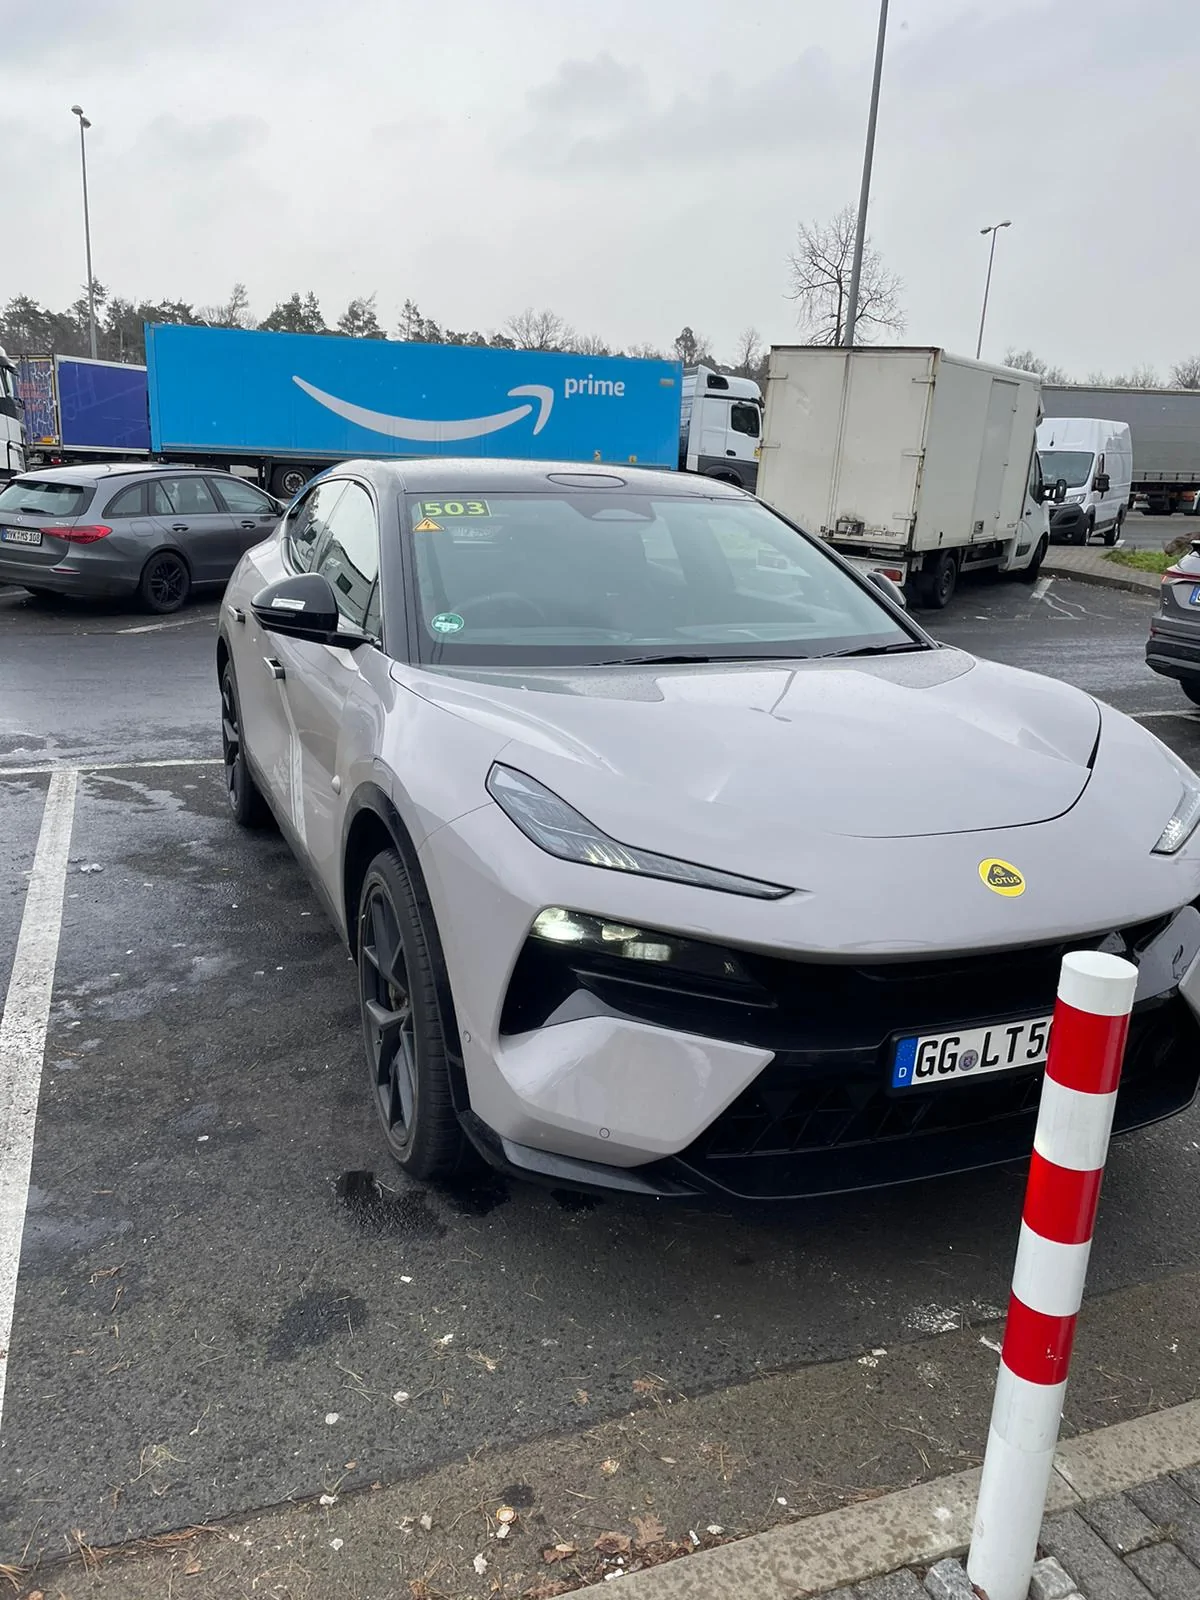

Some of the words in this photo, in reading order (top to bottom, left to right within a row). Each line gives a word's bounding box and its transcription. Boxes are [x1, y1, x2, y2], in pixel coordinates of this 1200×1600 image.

[564, 373, 626, 398] prime
[424, 502, 485, 516] 503
[989, 875, 1020, 885] LOTUS
[915, 1036, 961, 1078] GG
[1026, 1020, 1053, 1060] 5
[898, 1066, 907, 1078] D
